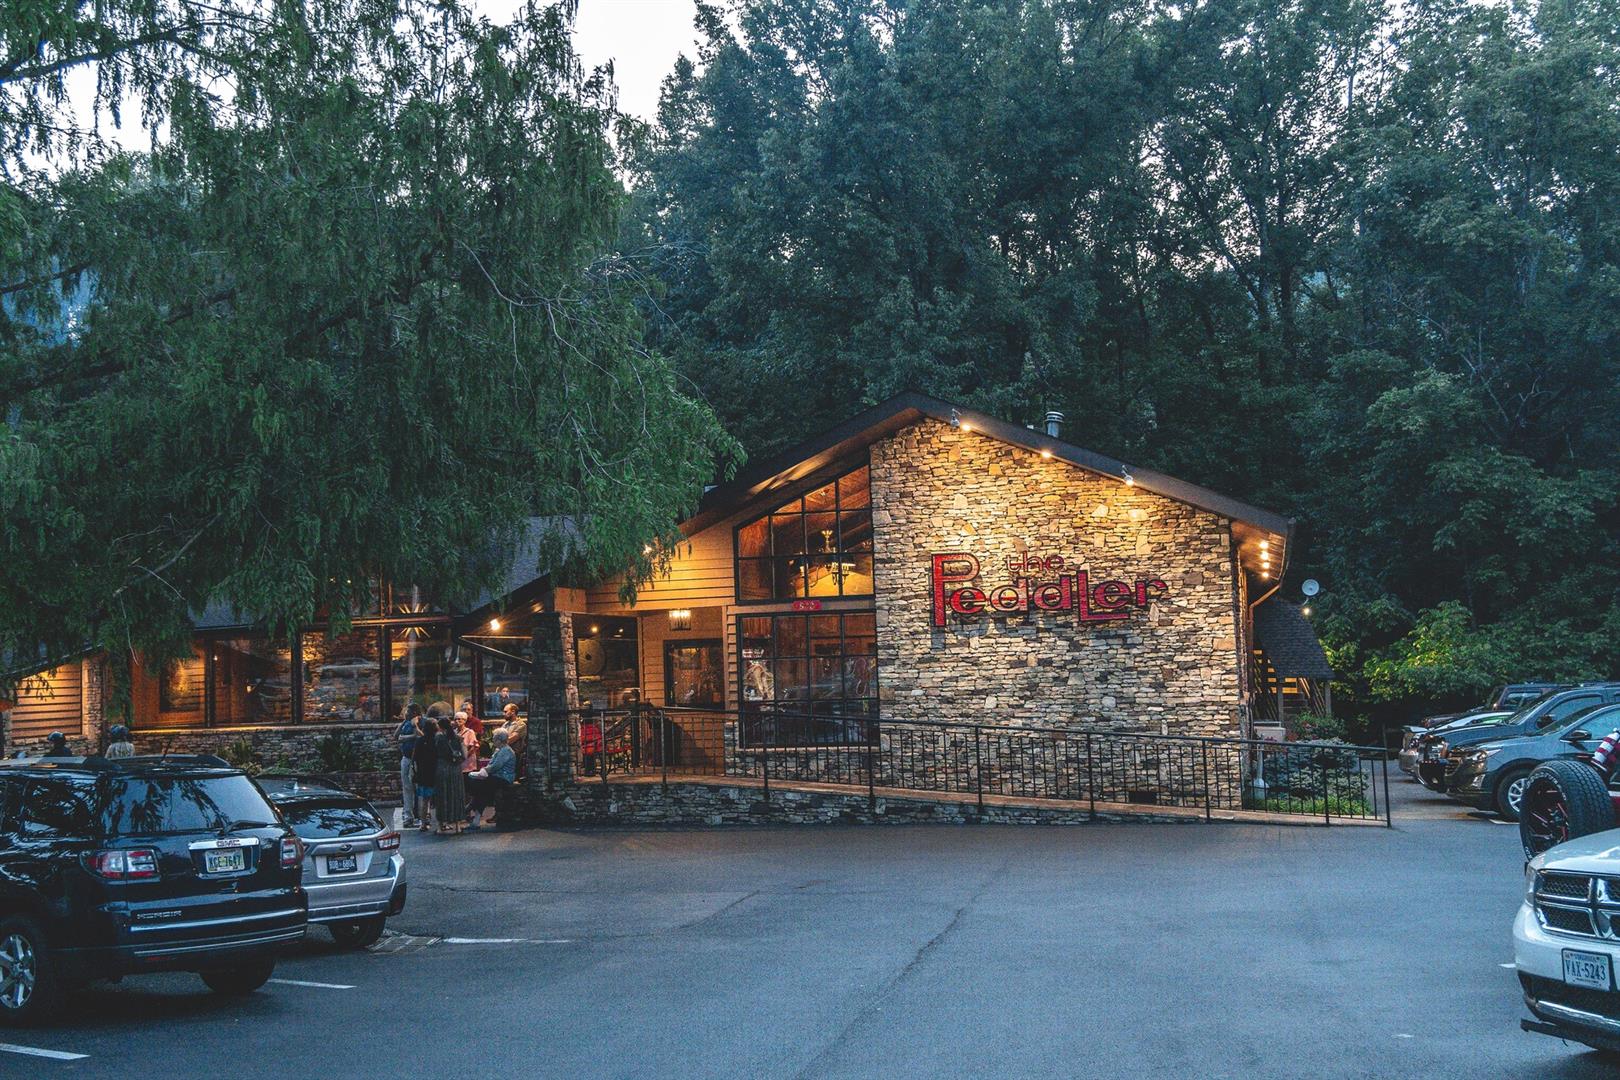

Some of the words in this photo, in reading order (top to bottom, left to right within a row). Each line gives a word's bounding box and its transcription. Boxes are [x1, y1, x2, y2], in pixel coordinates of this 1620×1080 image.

[1006, 550, 1066, 572] the
[216, 839, 241, 848] GMC
[1565, 959, 1607, 981] VAX-5243
